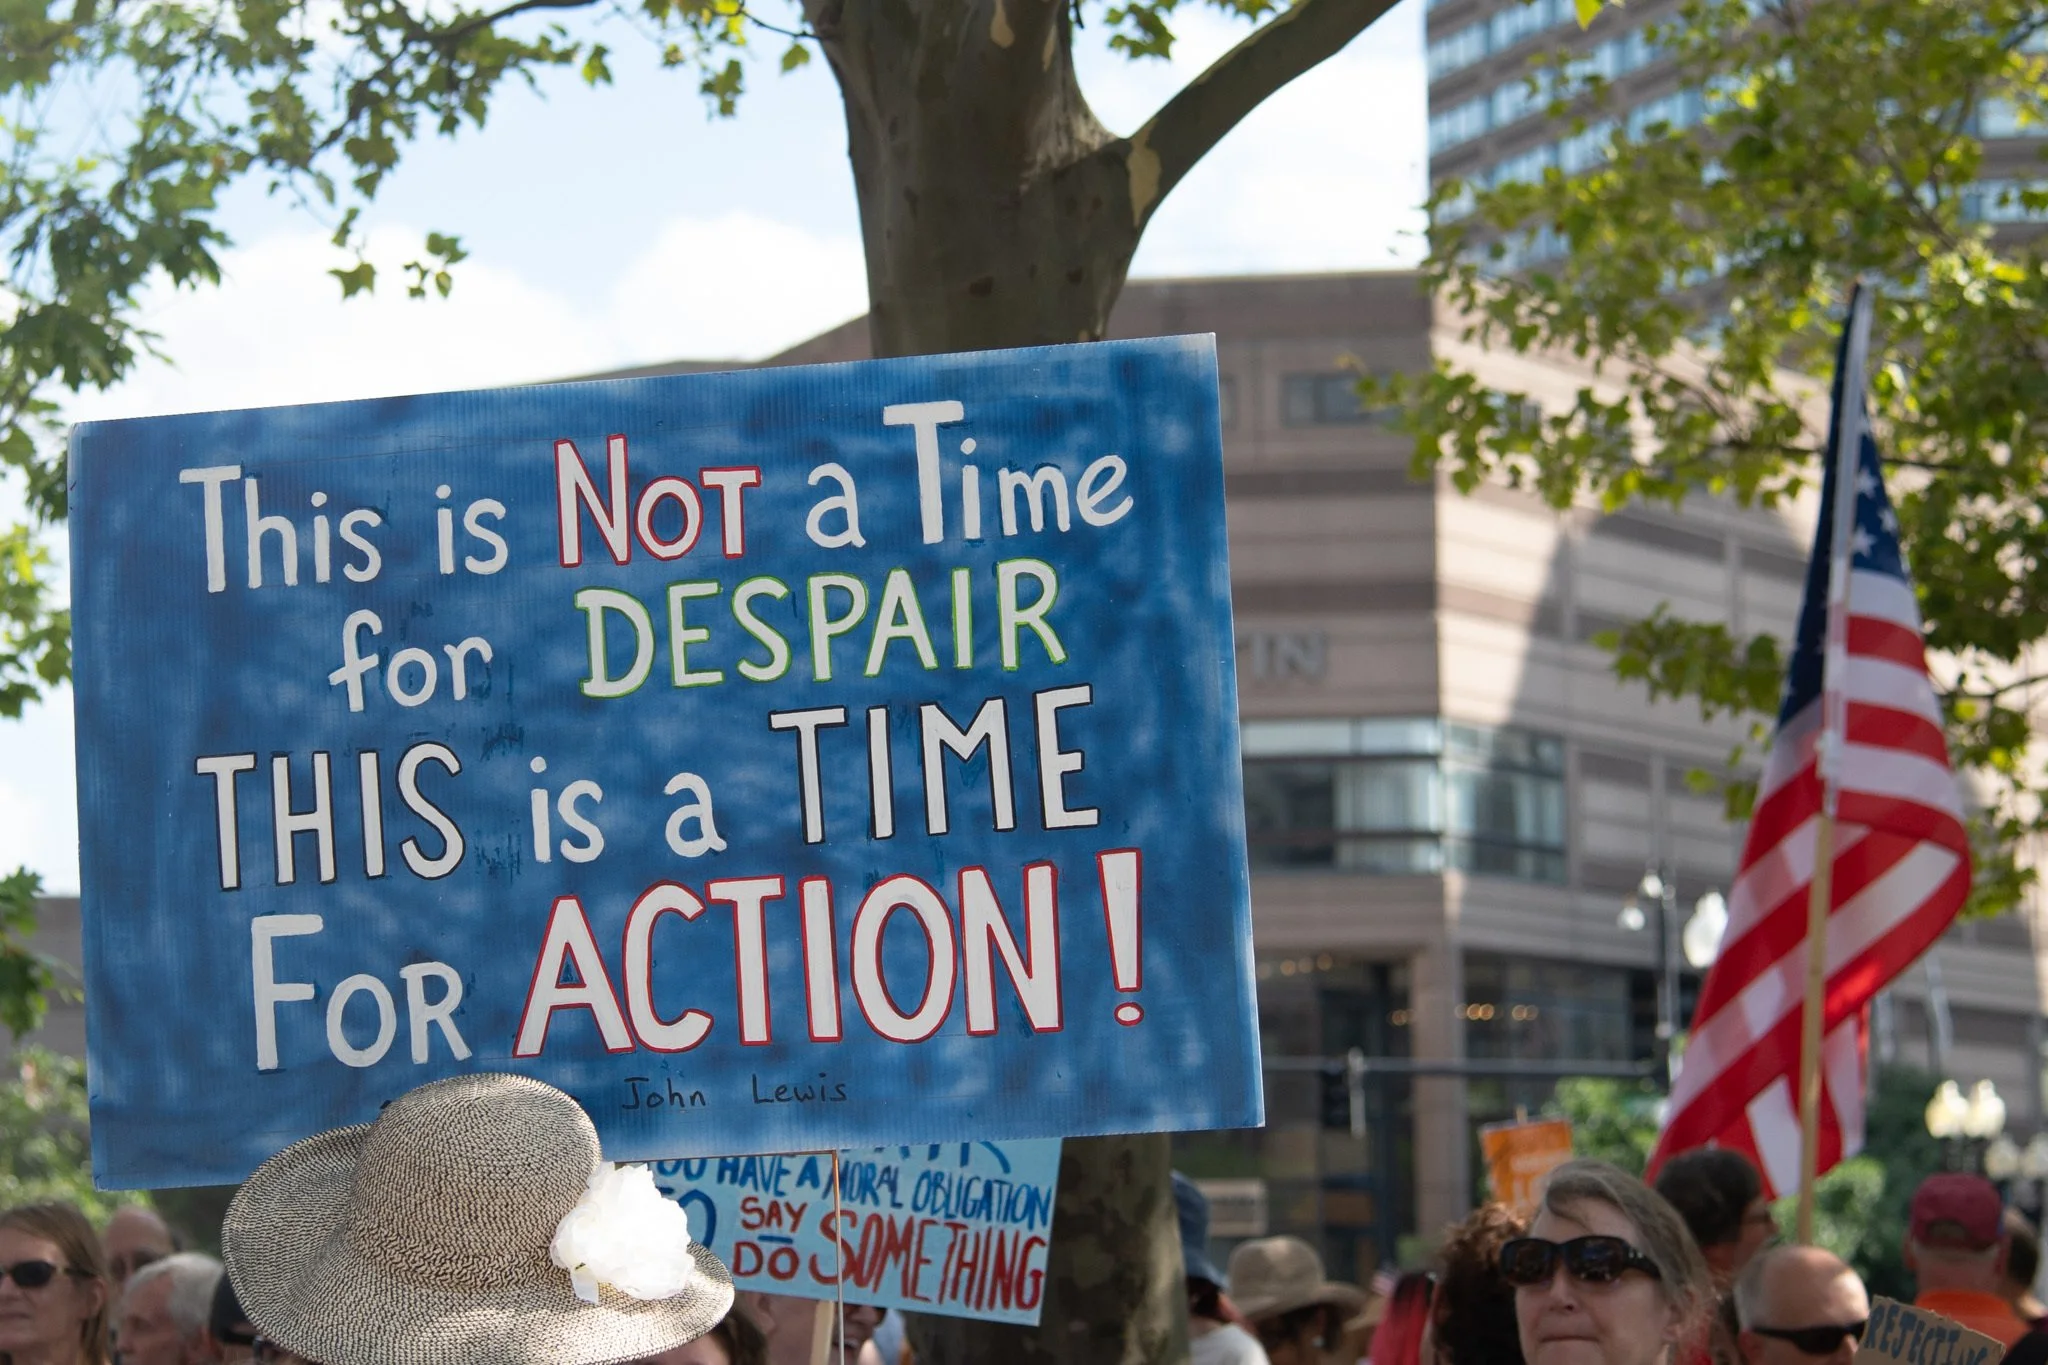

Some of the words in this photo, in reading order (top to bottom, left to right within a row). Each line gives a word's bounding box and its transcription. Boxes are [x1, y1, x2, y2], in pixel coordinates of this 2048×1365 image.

[179, 464, 382, 593] This
[436, 484, 508, 575] is
[805, 462, 866, 549] a
[883, 400, 1134, 544] Time
[329, 609, 493, 712] for
[574, 558, 1067, 698] DESPAIR
[195, 741, 466, 891] THIS
[530, 756, 605, 863] is
[663, 771, 728, 858] a
[767, 684, 1101, 845] TIME
[622, 1076, 707, 1110] John
[751, 1072, 848, 1104] Lewis
[717, 1155, 792, 1198] HAVE
[796, 1156, 820, 1189] A
[822, 1158, 904, 1210] MORAL
[912, 1168, 1052, 1231] OBLIGATION
[740, 1196, 808, 1233] SAY
[731, 1240, 800, 1281] DO
[808, 1208, 1047, 1312] SOMETHING
